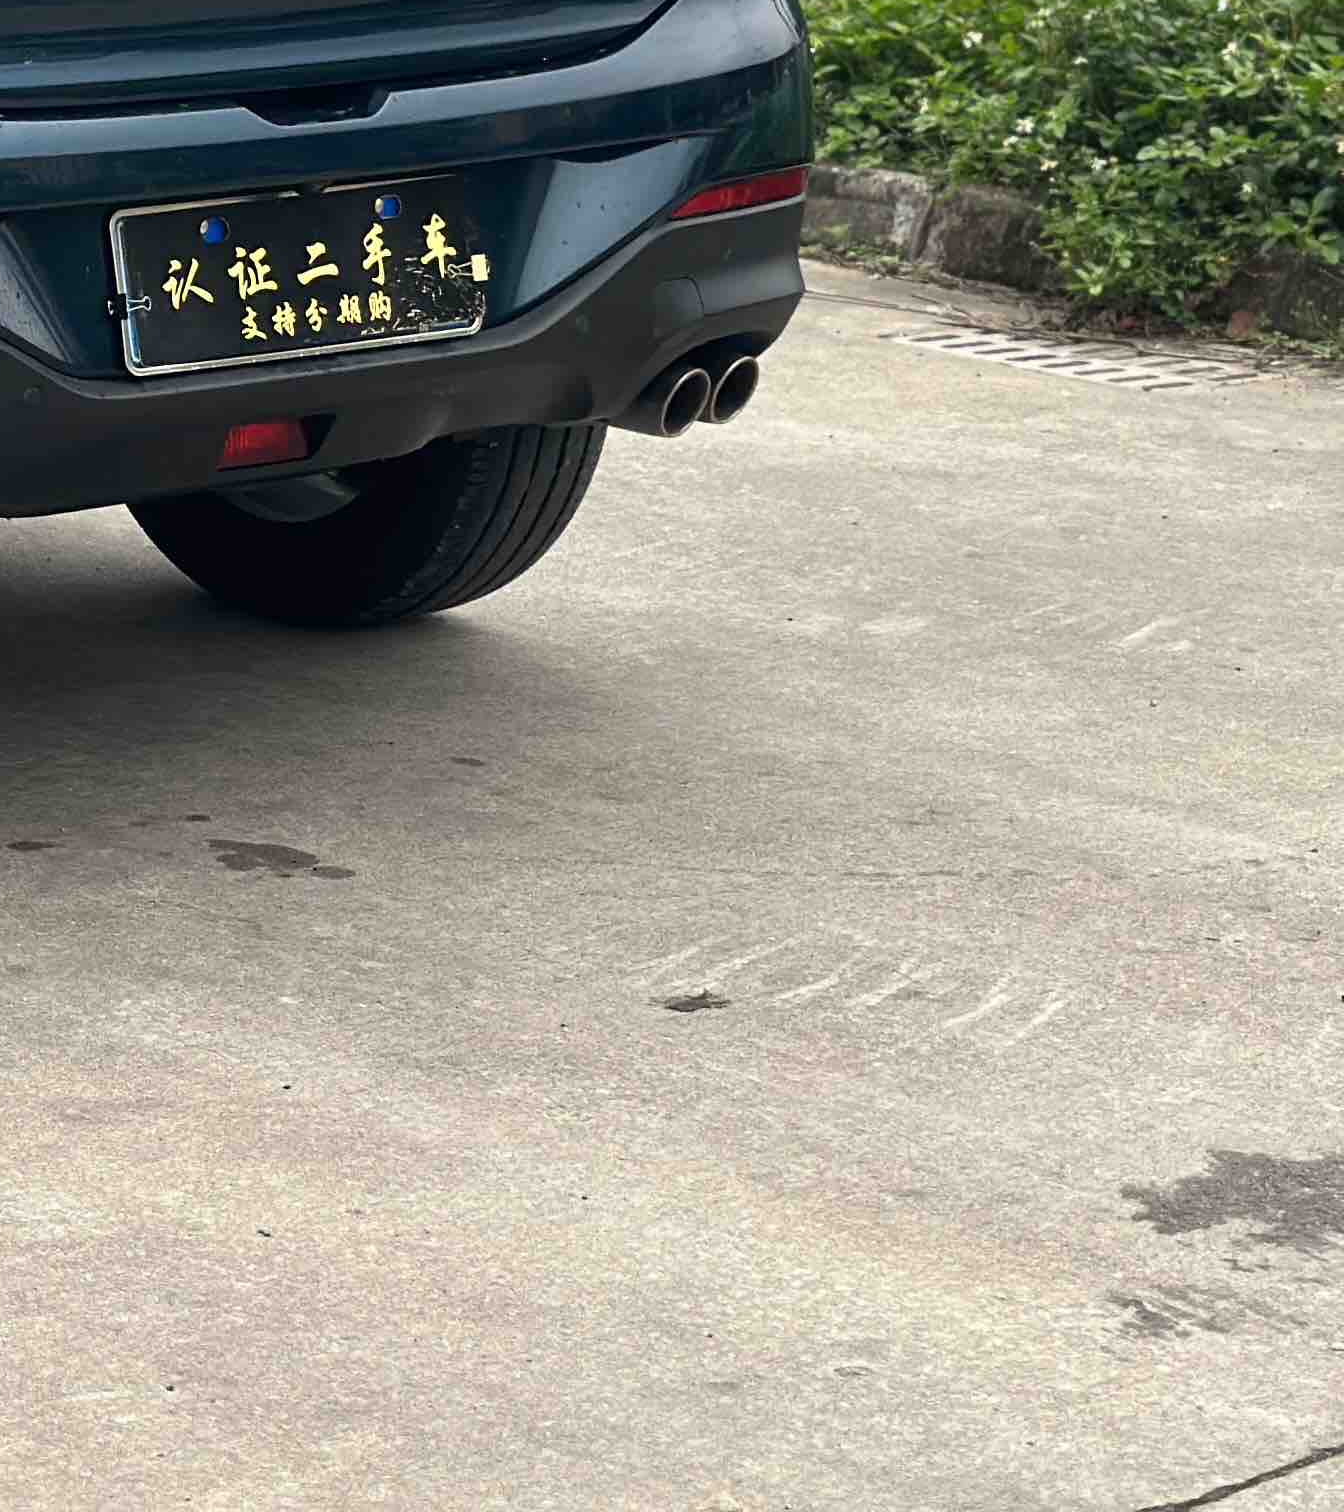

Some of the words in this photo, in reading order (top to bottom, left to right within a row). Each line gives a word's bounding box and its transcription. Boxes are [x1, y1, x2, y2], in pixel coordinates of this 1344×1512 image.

[162, 213, 457, 310] 认证二手车
[241, 291, 393, 340] 支持分期购
